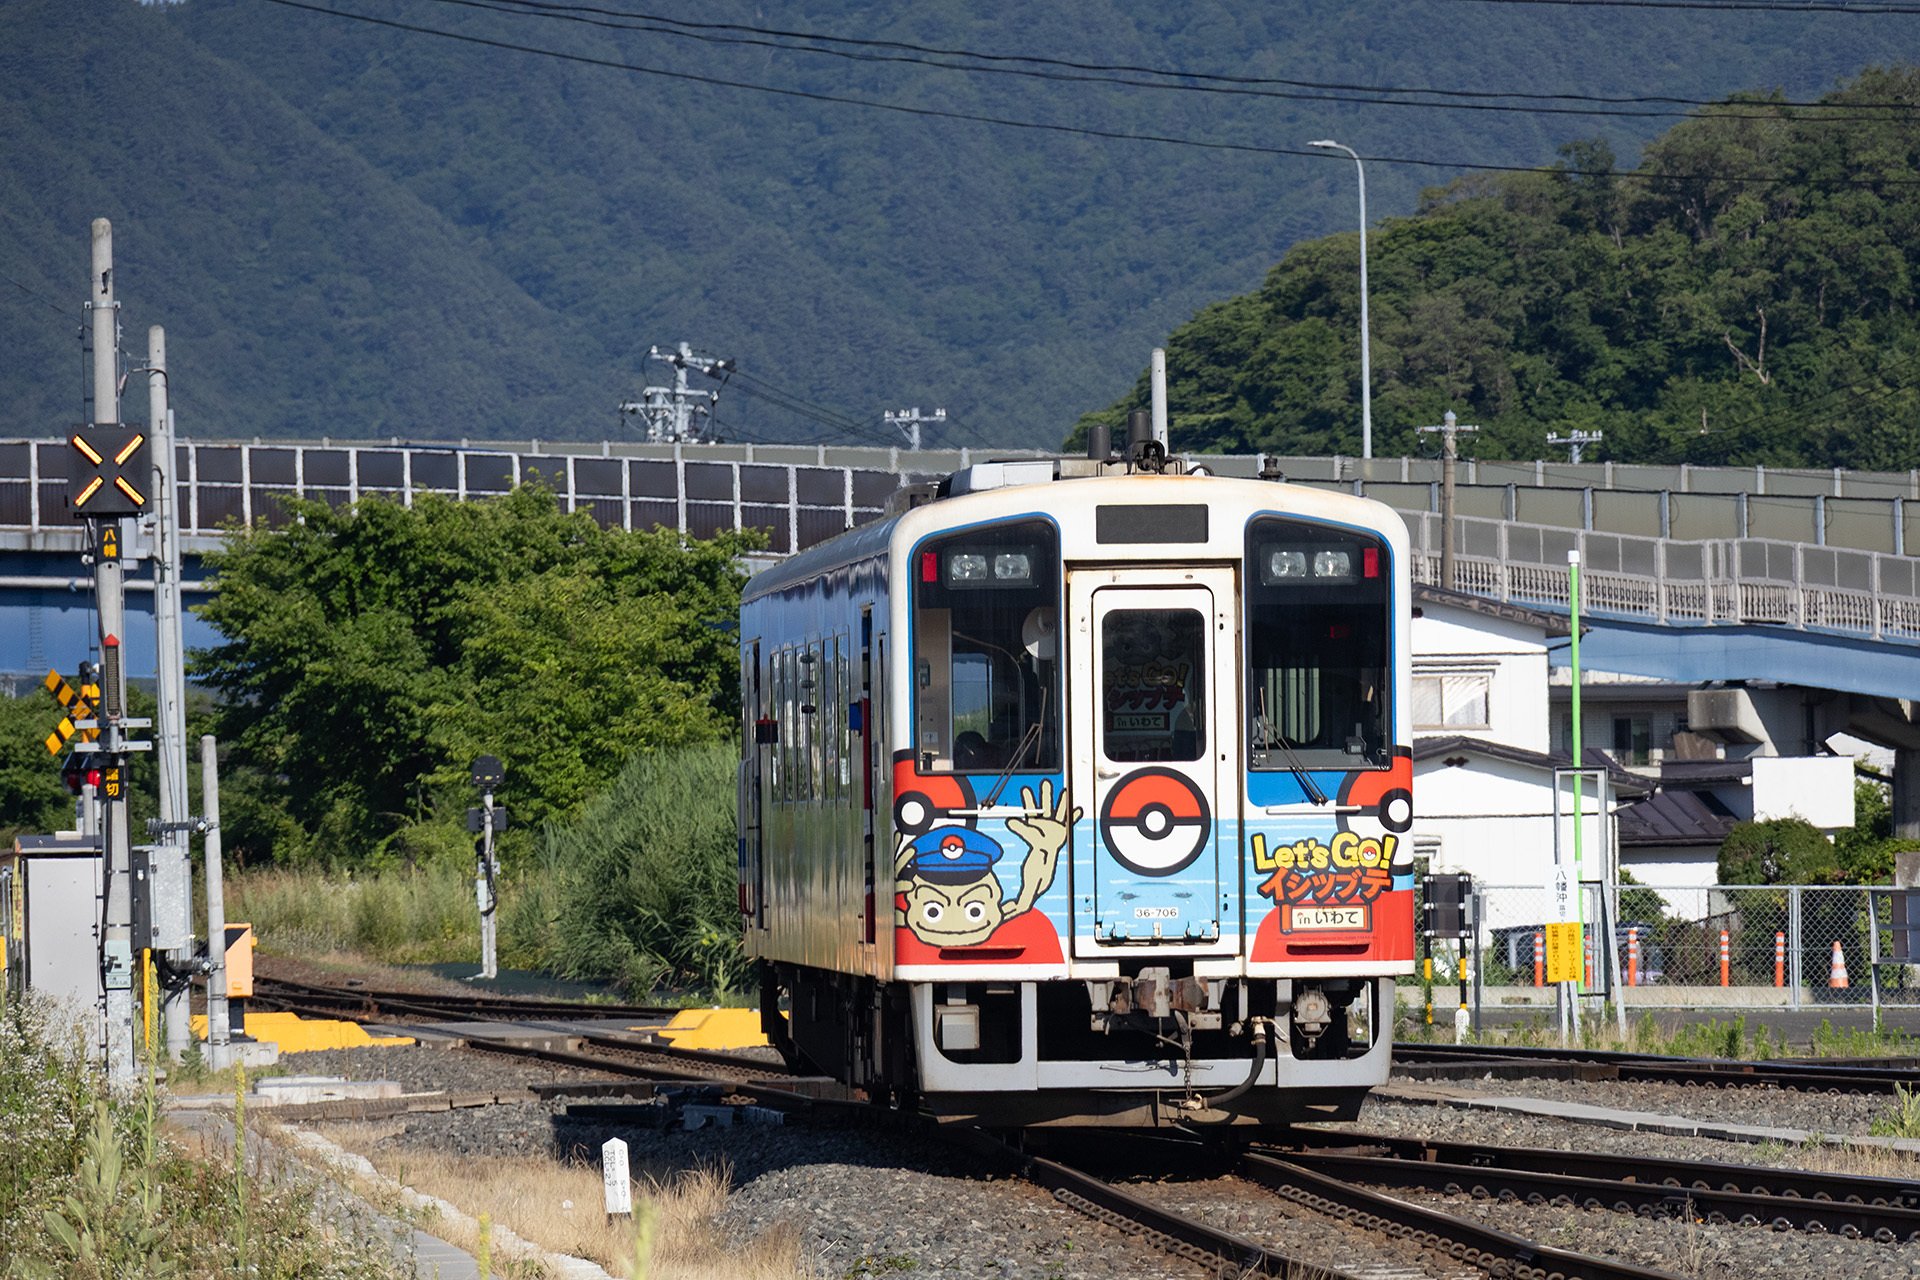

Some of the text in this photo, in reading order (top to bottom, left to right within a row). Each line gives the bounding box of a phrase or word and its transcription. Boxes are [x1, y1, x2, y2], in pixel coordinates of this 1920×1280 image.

[1129, 717, 1161, 727] いわて
[1253, 831, 1397, 870] Let's Go!
[1259, 867, 1393, 902] イシツブテ
[1136, 908, 1177, 918] 36-706
[1298, 910, 1359, 925] in いわて
